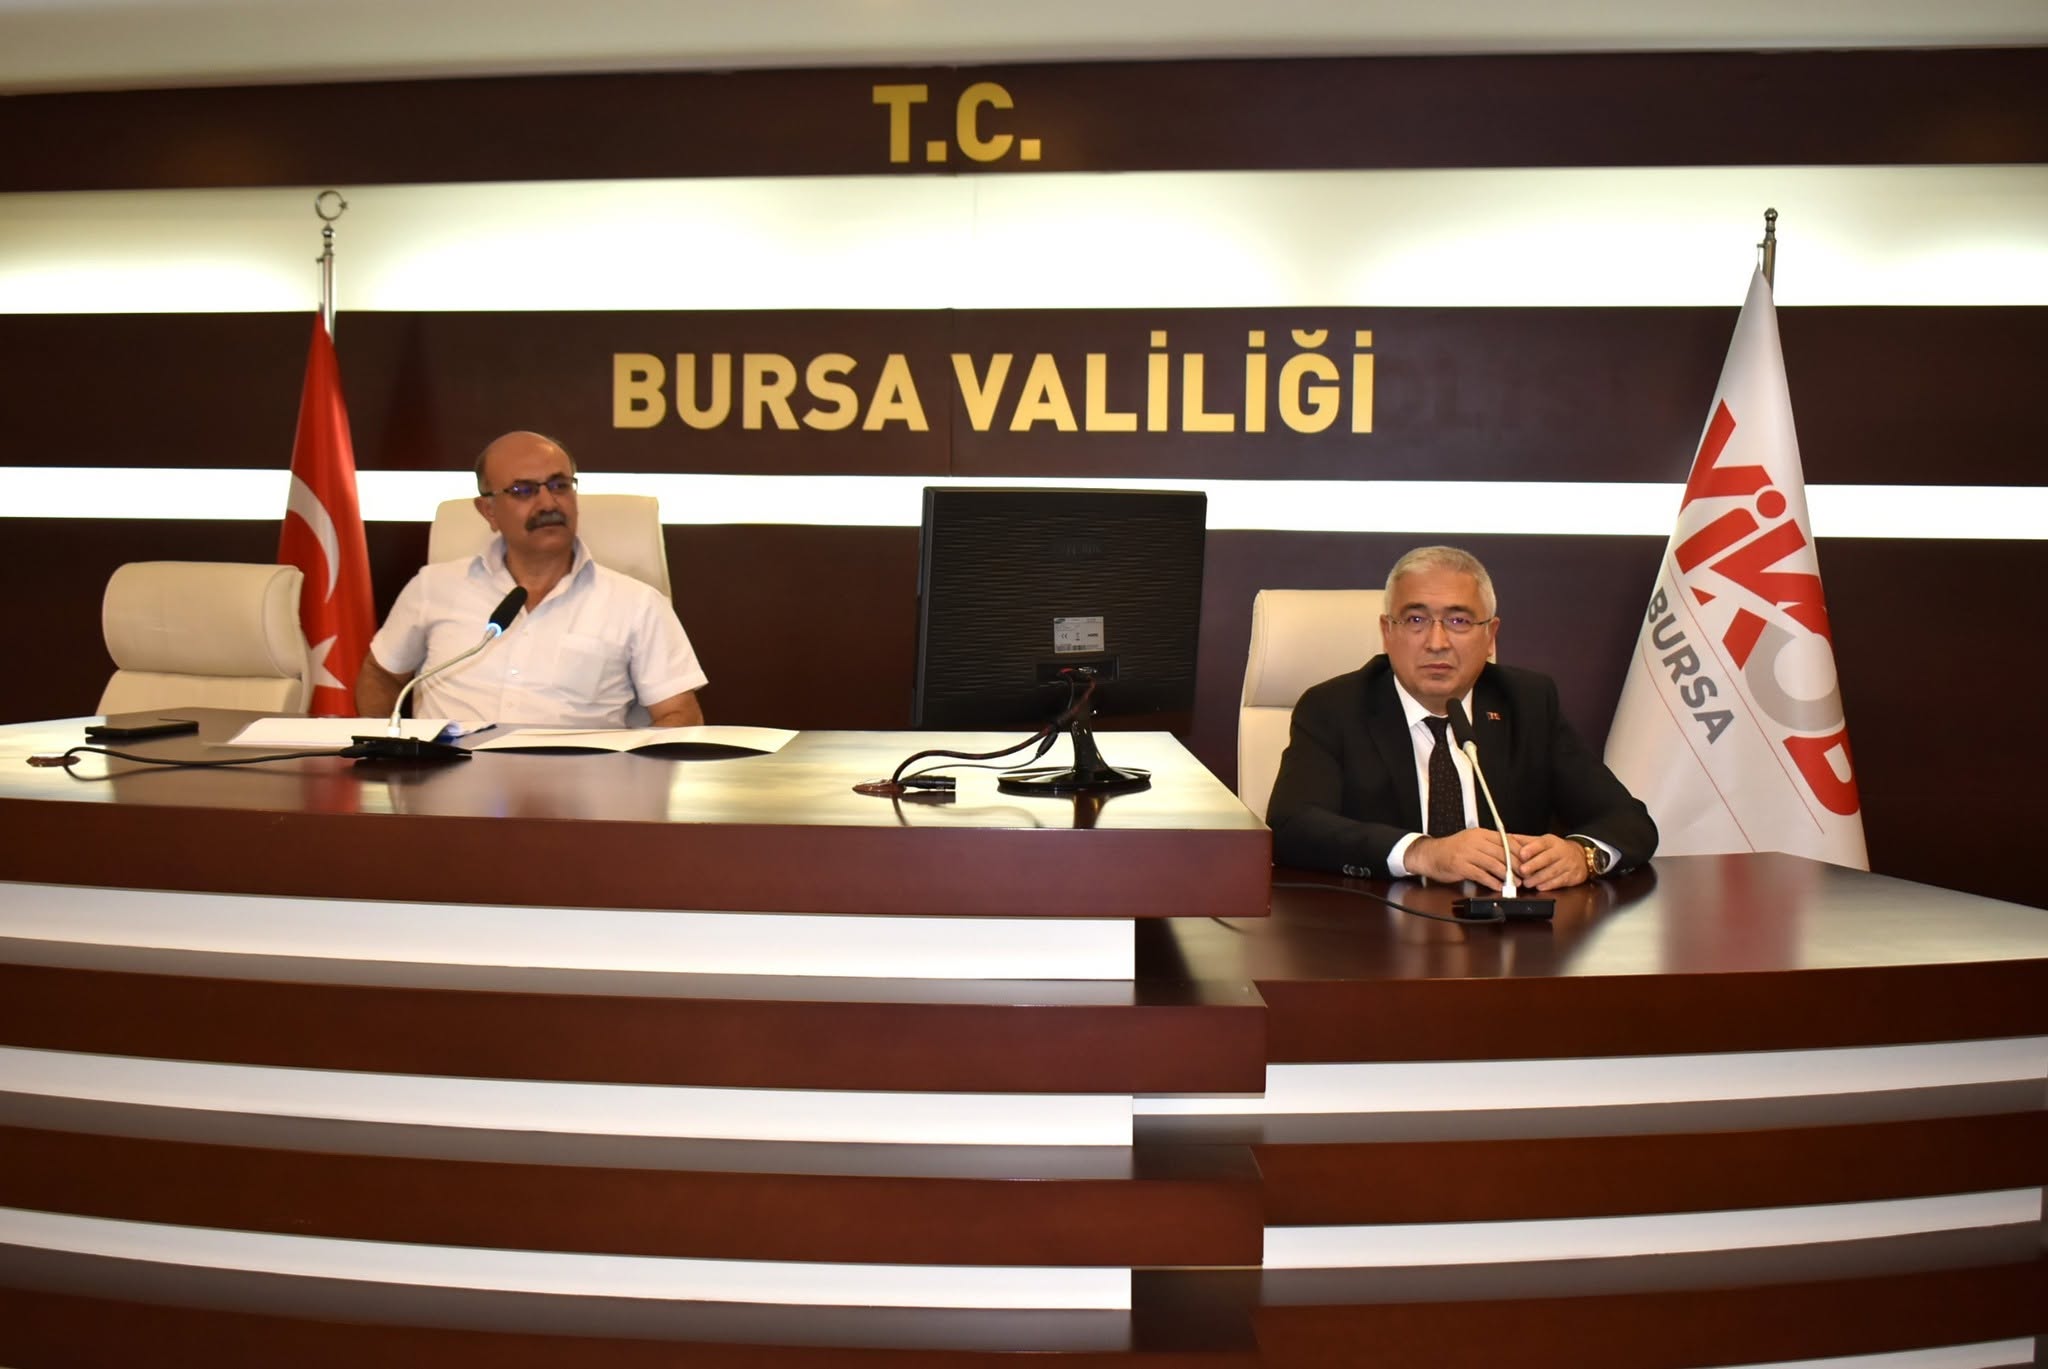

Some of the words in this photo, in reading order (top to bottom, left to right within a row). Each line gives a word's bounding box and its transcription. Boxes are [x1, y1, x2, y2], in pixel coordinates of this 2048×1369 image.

[872, 83, 1042, 163] T.C.
[612, 353, 930, 432] BURSA
[951, 329, 1375, 434] VALİLİĞİ
[1647, 587, 1735, 744] BURSA
